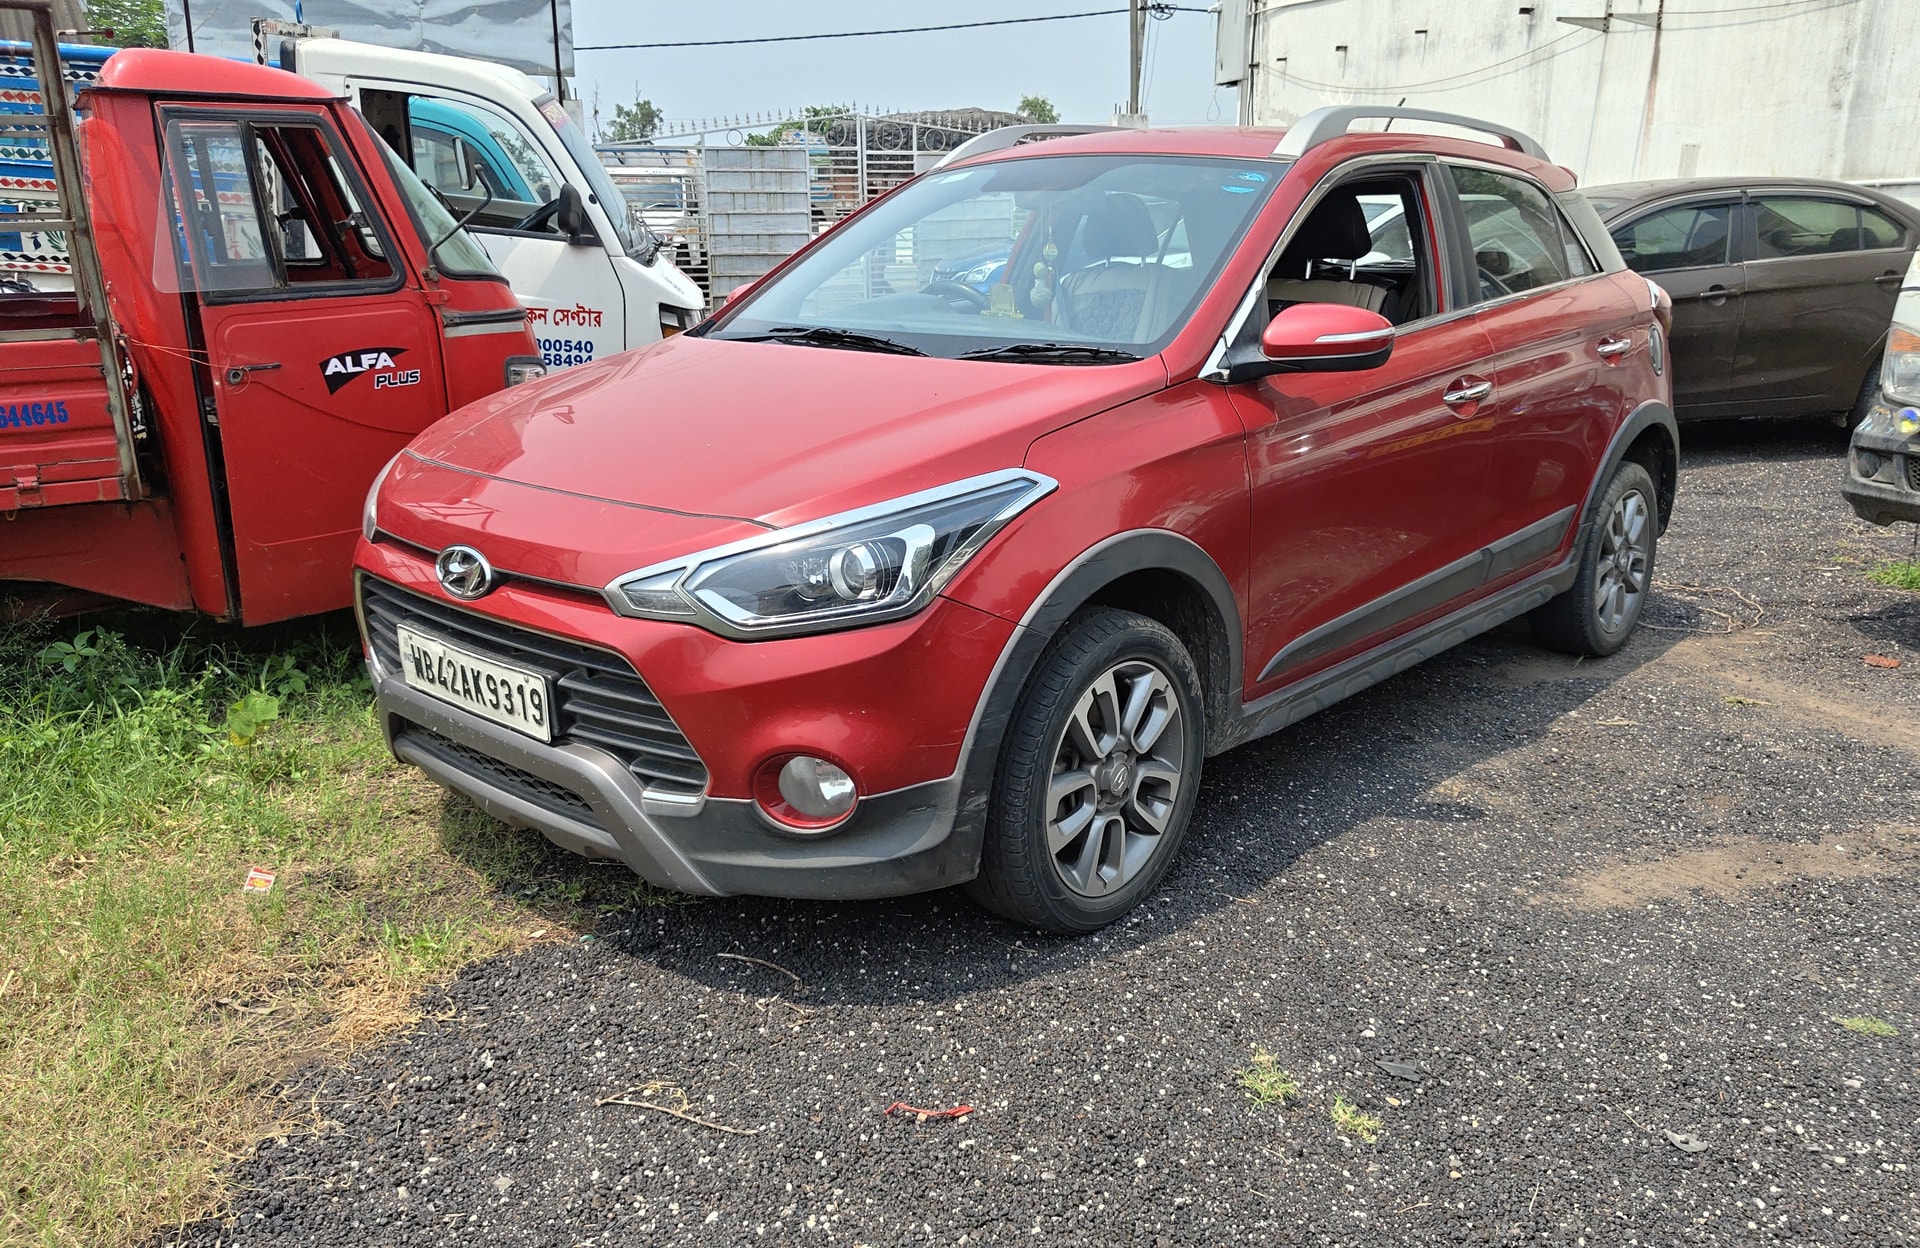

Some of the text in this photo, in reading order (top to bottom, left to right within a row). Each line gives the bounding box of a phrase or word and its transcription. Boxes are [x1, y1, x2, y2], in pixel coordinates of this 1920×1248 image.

[325, 351, 396, 375] ALFA
[375, 370, 420, 389] PLUS
[410, 643, 544, 725] WB42AK9319
